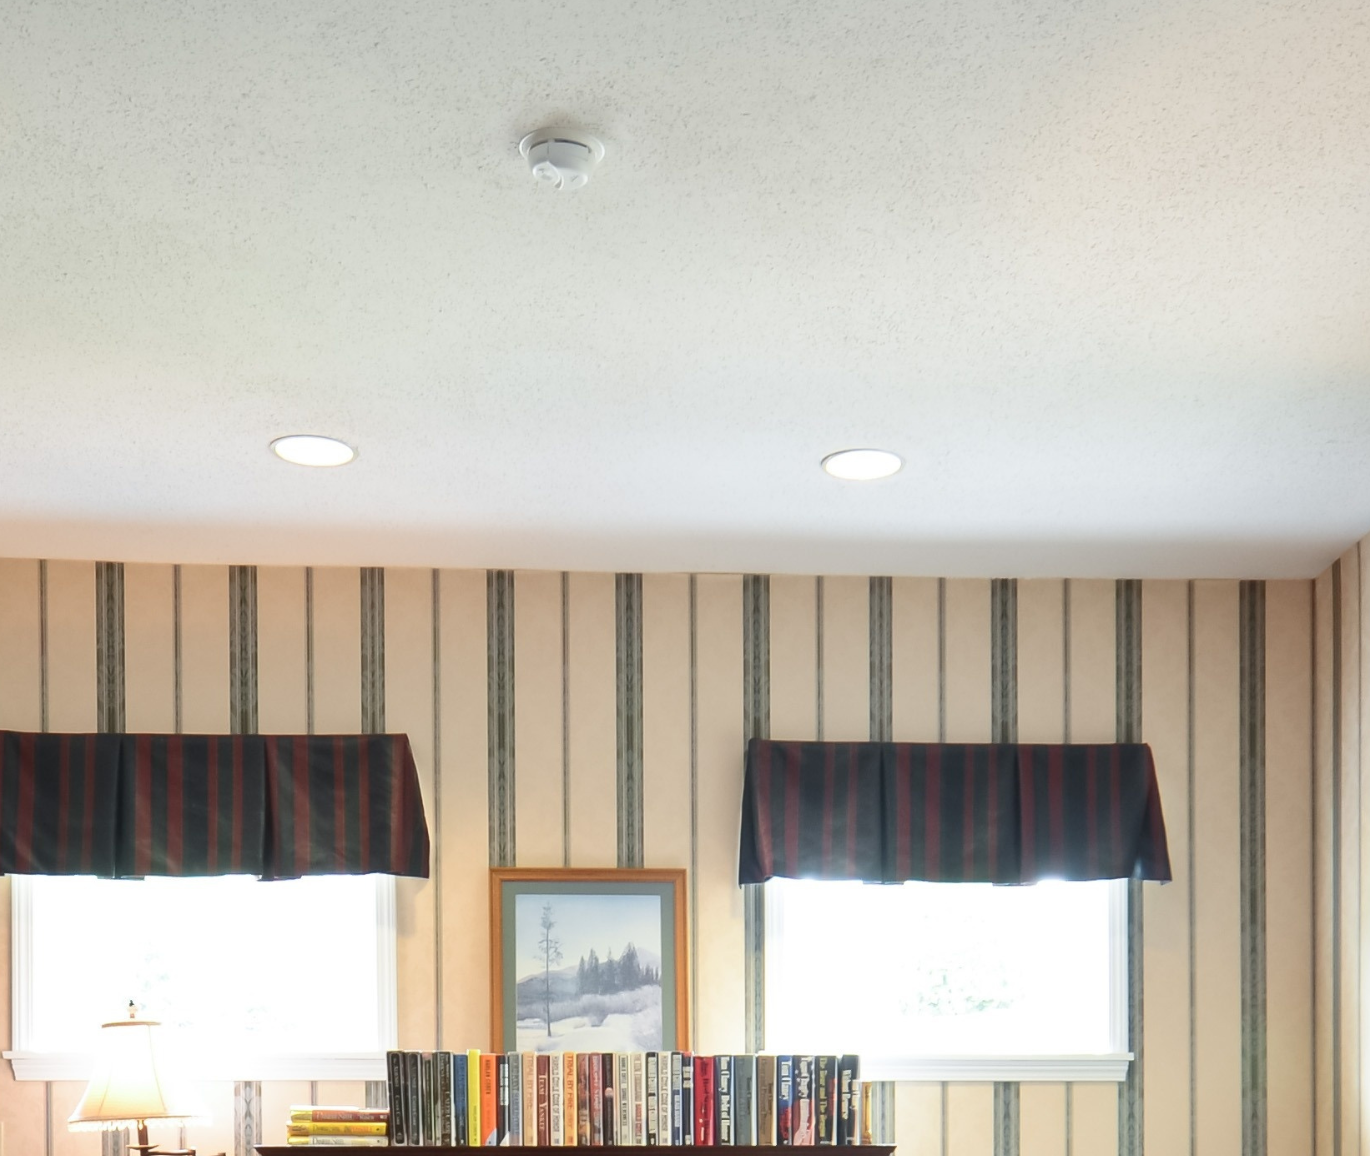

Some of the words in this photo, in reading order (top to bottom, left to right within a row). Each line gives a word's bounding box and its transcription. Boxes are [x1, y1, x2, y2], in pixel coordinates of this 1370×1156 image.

[781, 1061, 792, 1076] Tom
[539, 1074, 548, 1095] TEAM
[779, 1077, 792, 1100] Clancy
[539, 1101, 548, 1131] YANKEE
